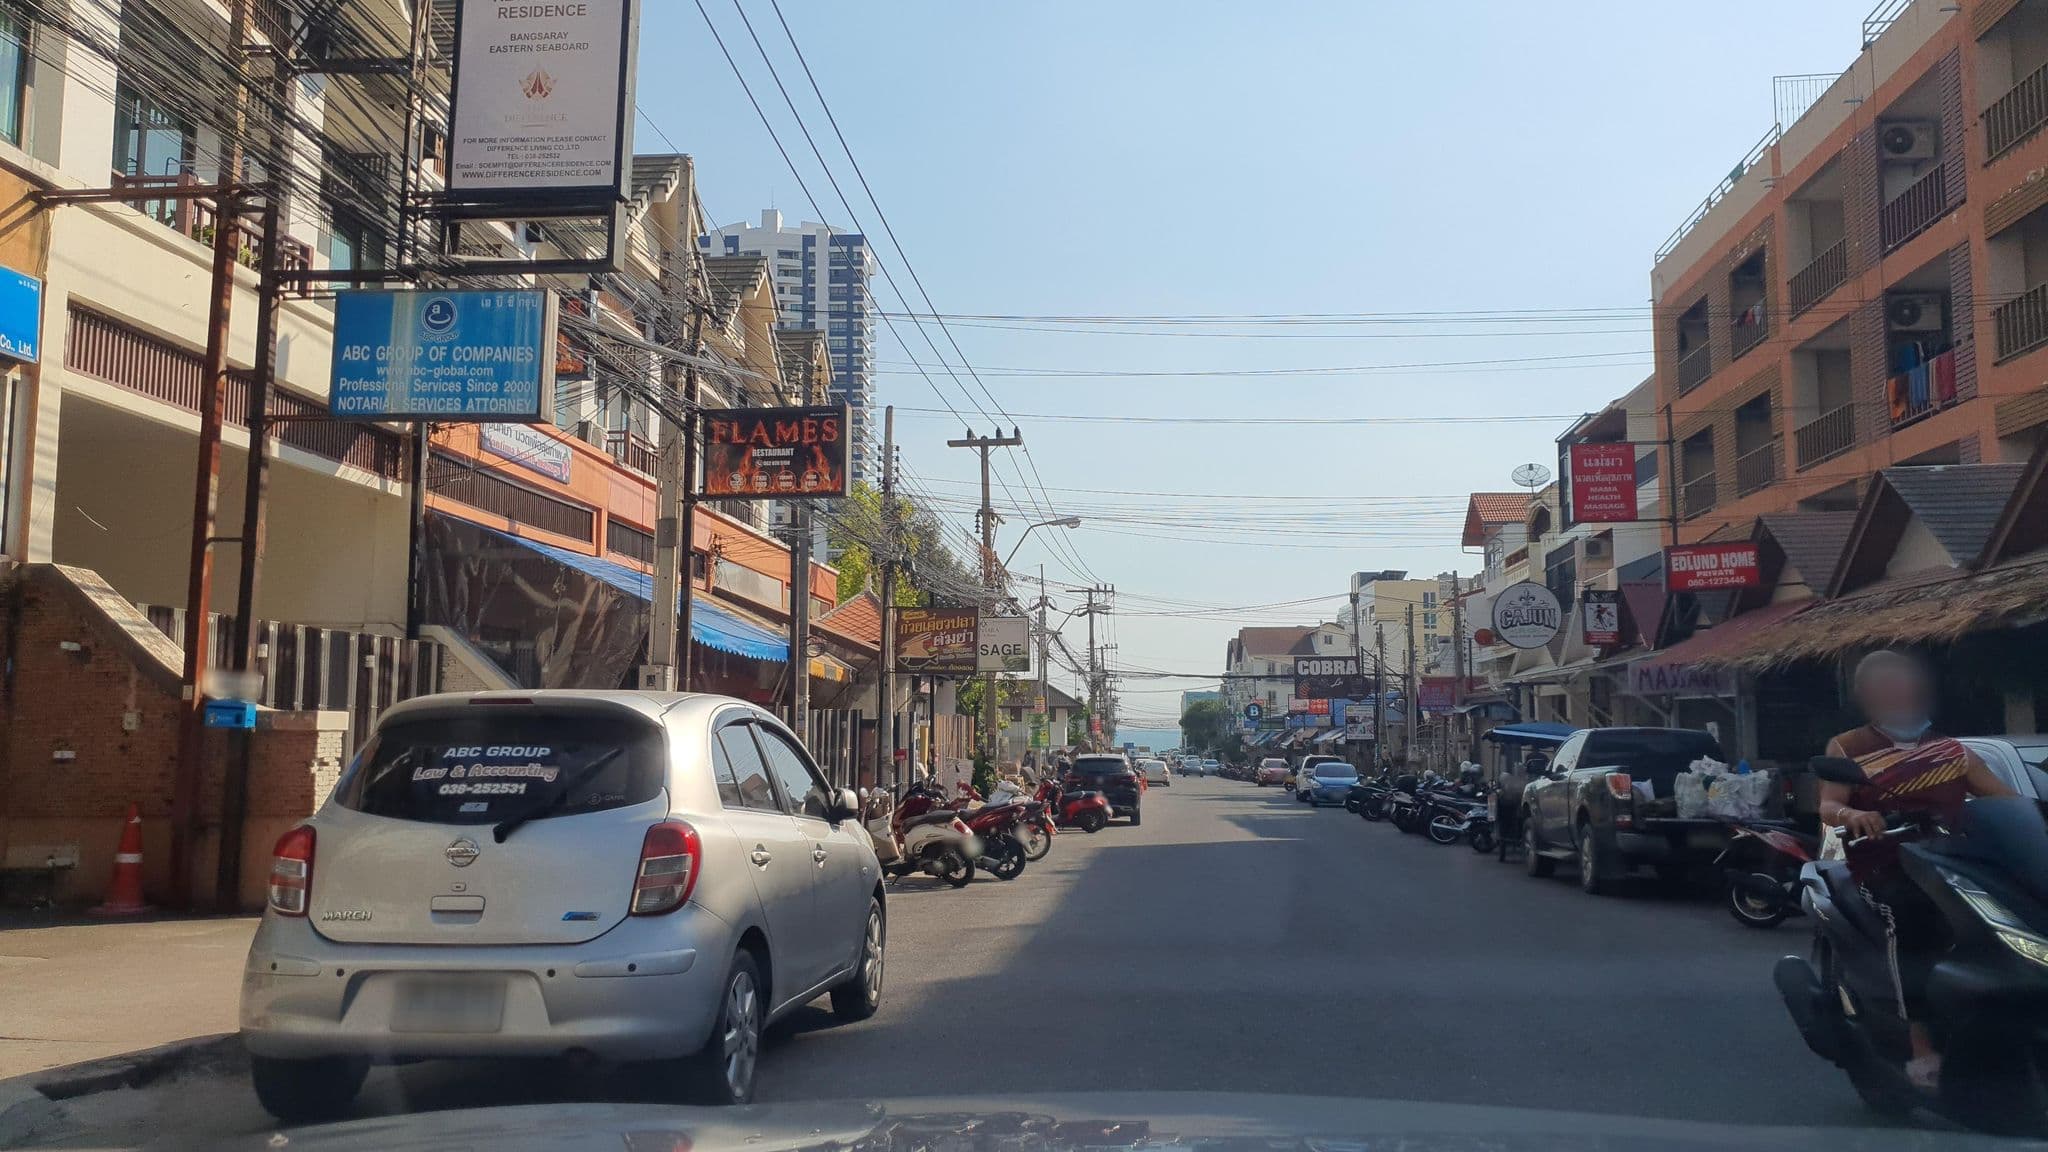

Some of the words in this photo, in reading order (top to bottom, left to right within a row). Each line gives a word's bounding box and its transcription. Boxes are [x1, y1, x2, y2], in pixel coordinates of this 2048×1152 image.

[498, 4, 587, 19] RESIDENCE
[510, 31, 569, 42] BANGSARAY
[489, 44, 534, 54] EASTERN
[535, 42, 589, 52] SEABOARD
[499, 136, 545, 144] INFORMATION
[19, 340, 33, 357] Ltd.
[342, 346, 371, 361] ABC
[376, 346, 424, 362] GROUP
[428, 346, 448, 361] OF
[452, 346, 534, 362] COMPANIES
[339, 377, 407, 393] Professional
[413, 379, 462, 393] Services
[466, 380, 498, 393] Since
[338, 397, 397, 411] NOTARIAL
[403, 397, 462, 412] SERVICES
[465, 397, 531, 412] ATTORNEY
[711, 418, 839, 448] FLAMES
[752, 447, 795, 457] RESTAURANT
[1671, 554, 1718, 572] EDLUND
[1721, 551, 1756, 568] HOME
[1696, 569, 1735, 577] PRIVATE
[1500, 608, 1556, 630] CAJUN
[1297, 660, 1358, 676] COBRA
[443, 747, 482, 758] ABC
[485, 746, 551, 758] GROUP
[412, 766, 448, 781] Law
[450, 765, 466, 778] &
[467, 763, 560, 782] Accounting
[438, 783, 527, 795] 038-252531
[321, 911, 373, 921] MARCH
